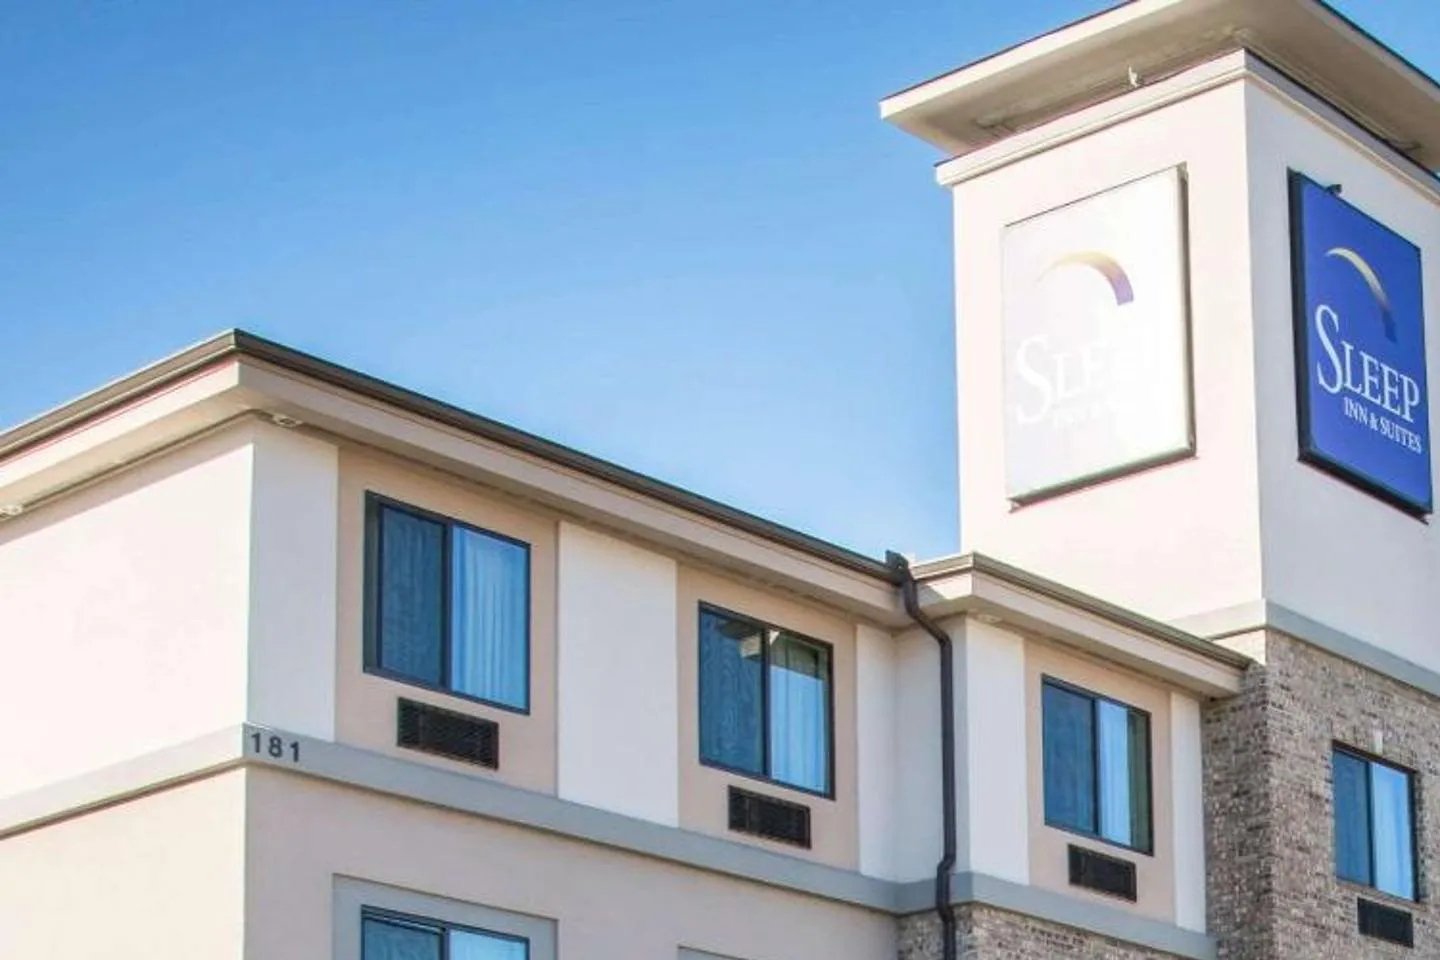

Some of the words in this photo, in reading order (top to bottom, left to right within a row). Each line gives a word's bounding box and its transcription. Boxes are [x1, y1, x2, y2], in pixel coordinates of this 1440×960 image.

[1314, 304, 1420, 424] SLEEP
[1343, 396, 1368, 425] INN
[1369, 412, 1379, 431] &
[1380, 416, 1422, 454] SUITES
[251, 731, 300, 762] 181
